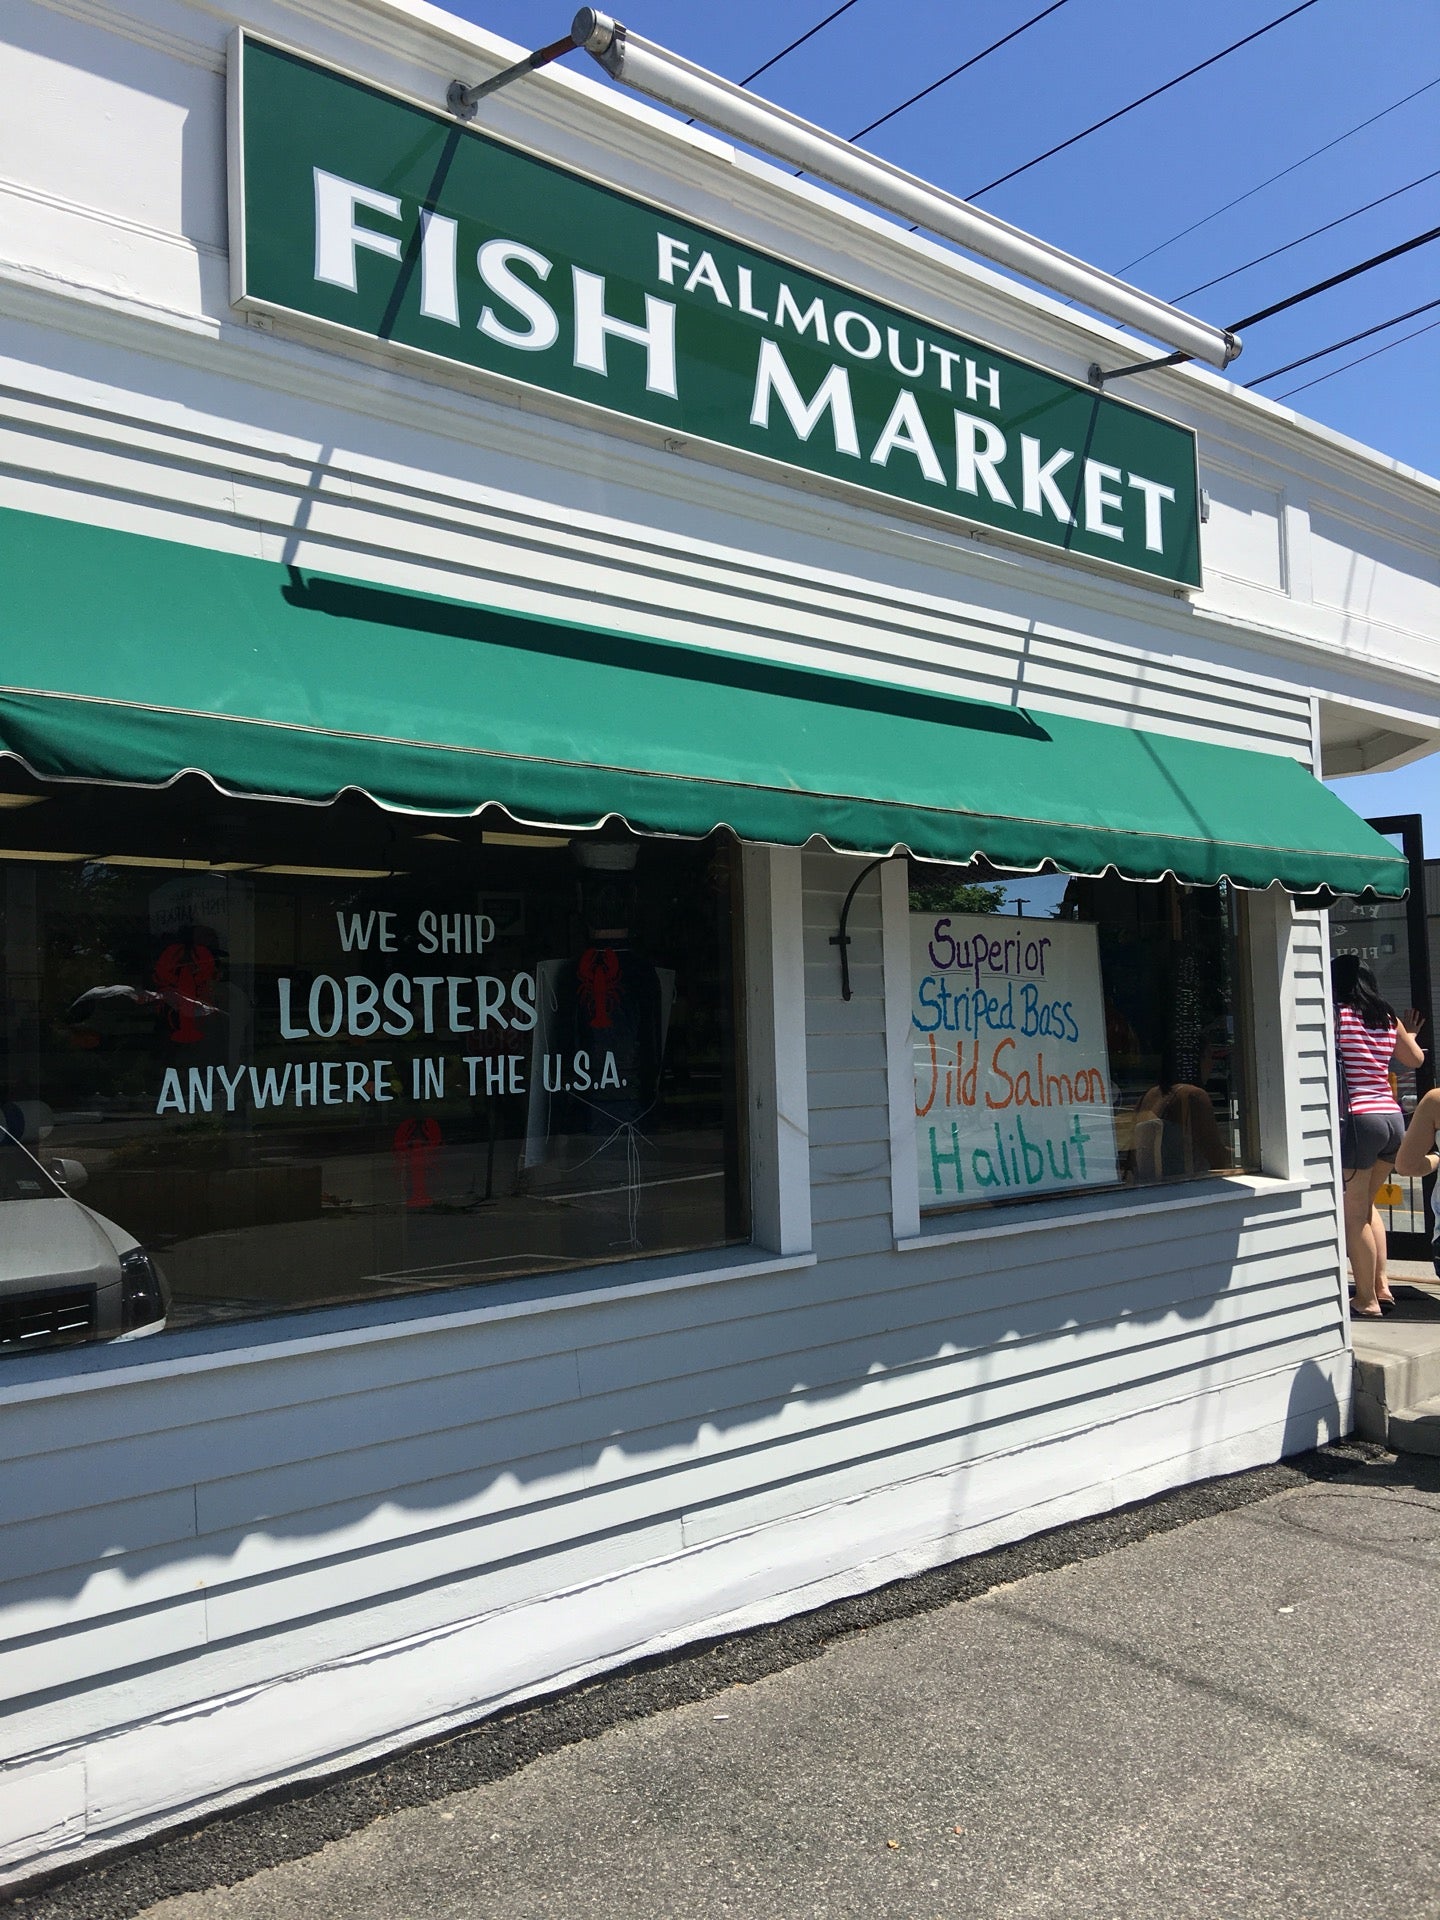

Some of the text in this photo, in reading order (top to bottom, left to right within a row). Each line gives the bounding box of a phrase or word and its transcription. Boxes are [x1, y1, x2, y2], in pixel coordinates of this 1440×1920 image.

[656, 231, 1001, 411] FALMOUTH
[313, 166, 1176, 555] FISH MARKET
[337, 910, 496, 955] WE SHIP
[928, 918, 1051, 989] Superior
[278, 972, 538, 1040] LOBSTERS
[912, 976, 1079, 1042] Striped Bass
[155, 1050, 629, 1116] ANYWHERE IN THE U.S.A.
[985, 1037, 1107, 1110] Salmon
[929, 1114, 1091, 1195] Halibut
